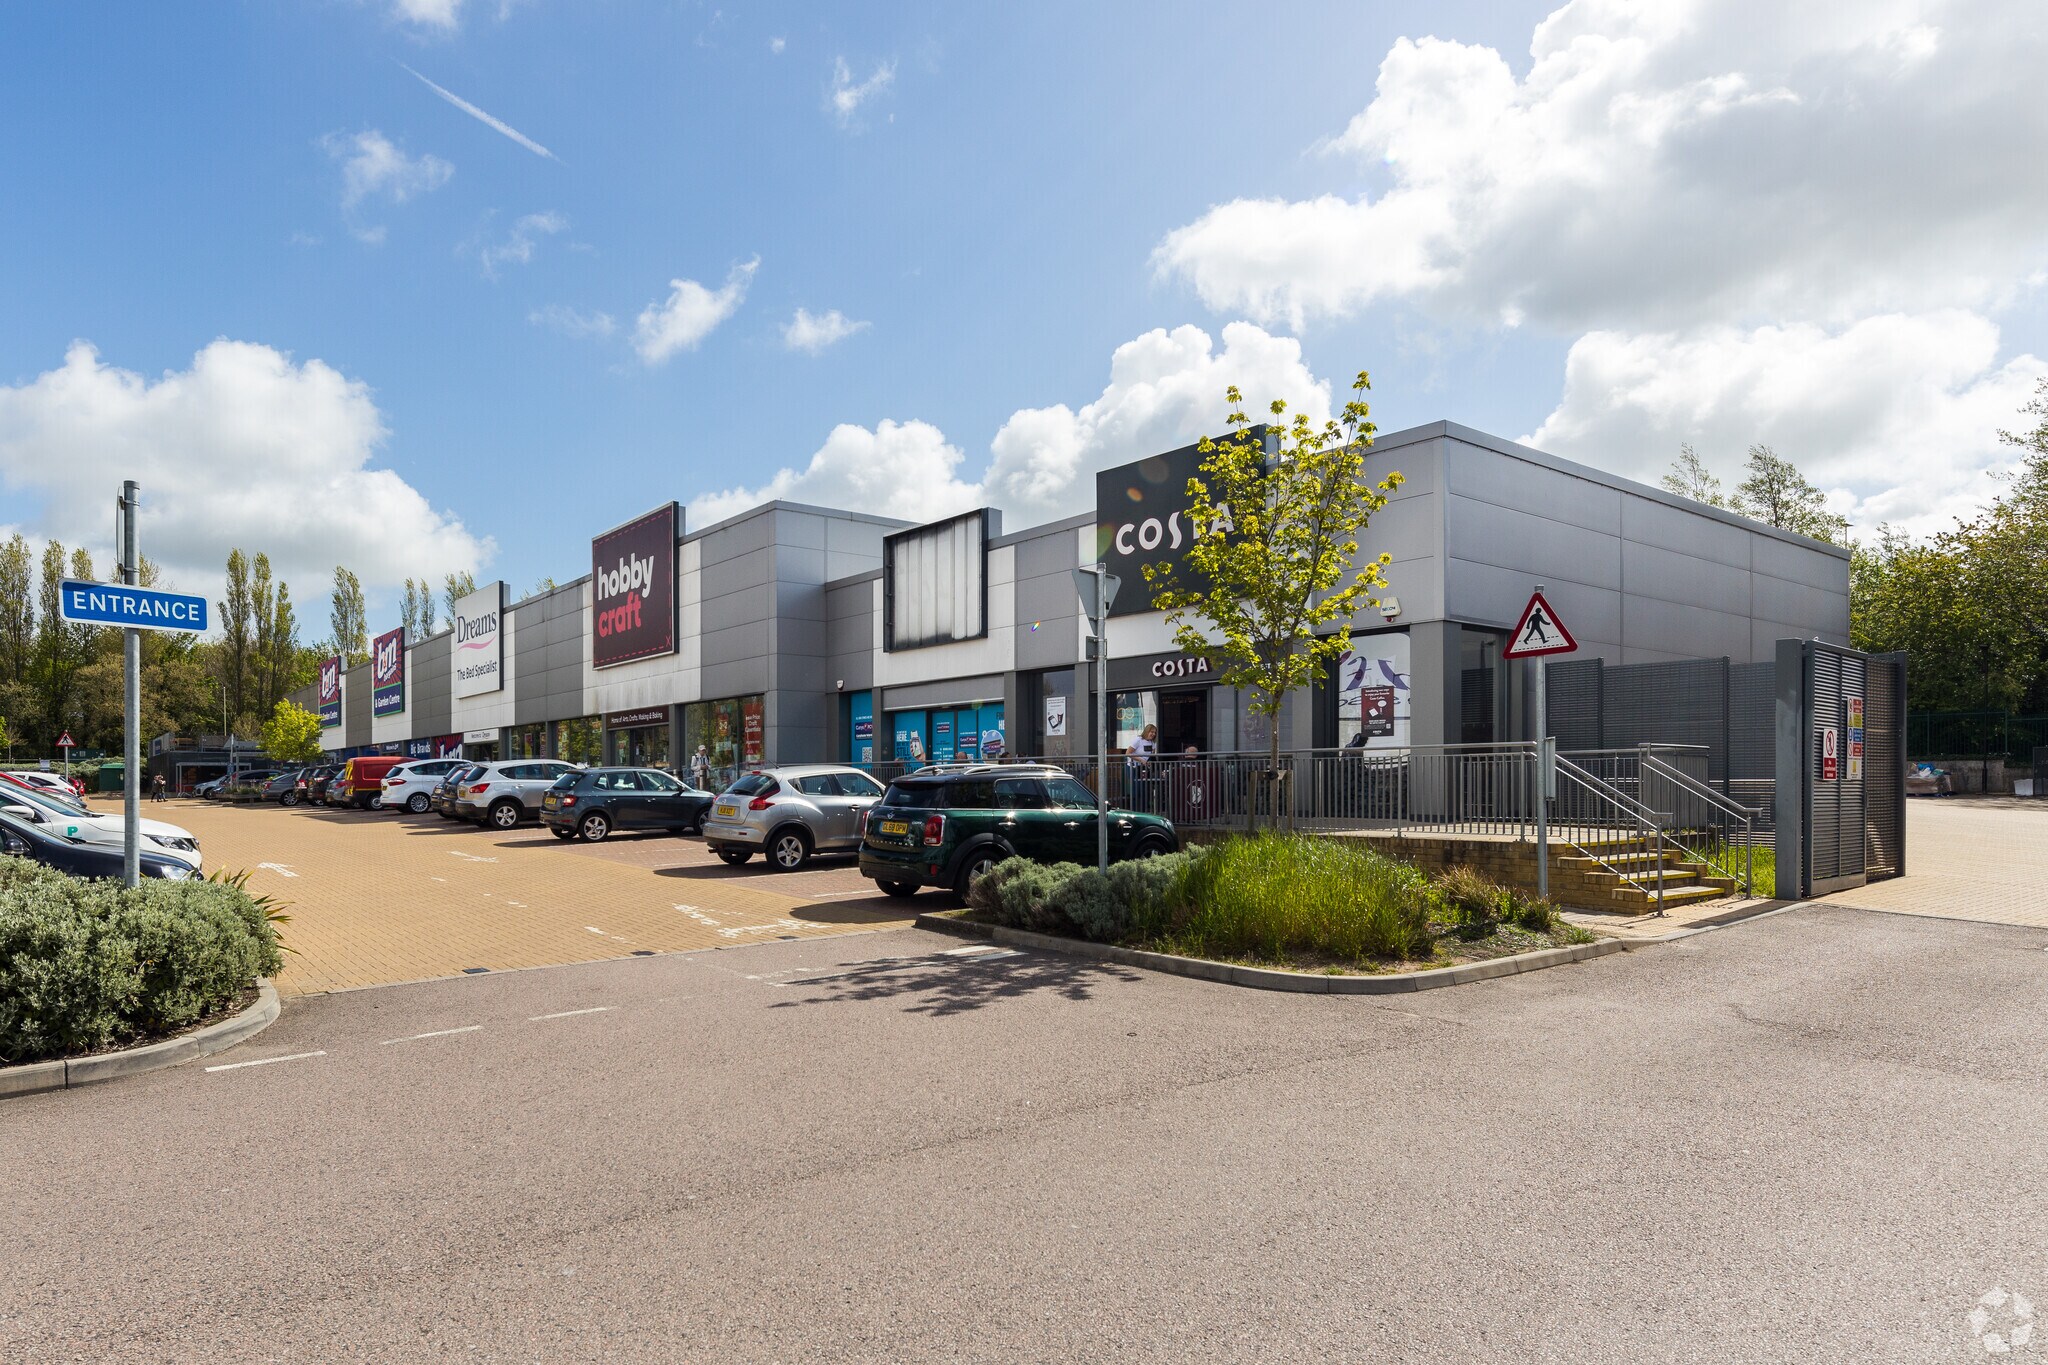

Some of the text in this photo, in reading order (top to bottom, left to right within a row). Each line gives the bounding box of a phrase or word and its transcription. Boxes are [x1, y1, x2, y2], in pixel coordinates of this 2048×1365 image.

[597, 552, 655, 601] hobby
[73, 591, 200, 621] ENTRANCE
[598, 591, 642, 638] craft
[457, 611, 497, 644] Dreams
[457, 660, 497, 681] The Bed Specialist
[1152, 656, 1208, 677] COSTA
[417, 742, 431, 754] Brands
[67, 826, 78, 836] P
